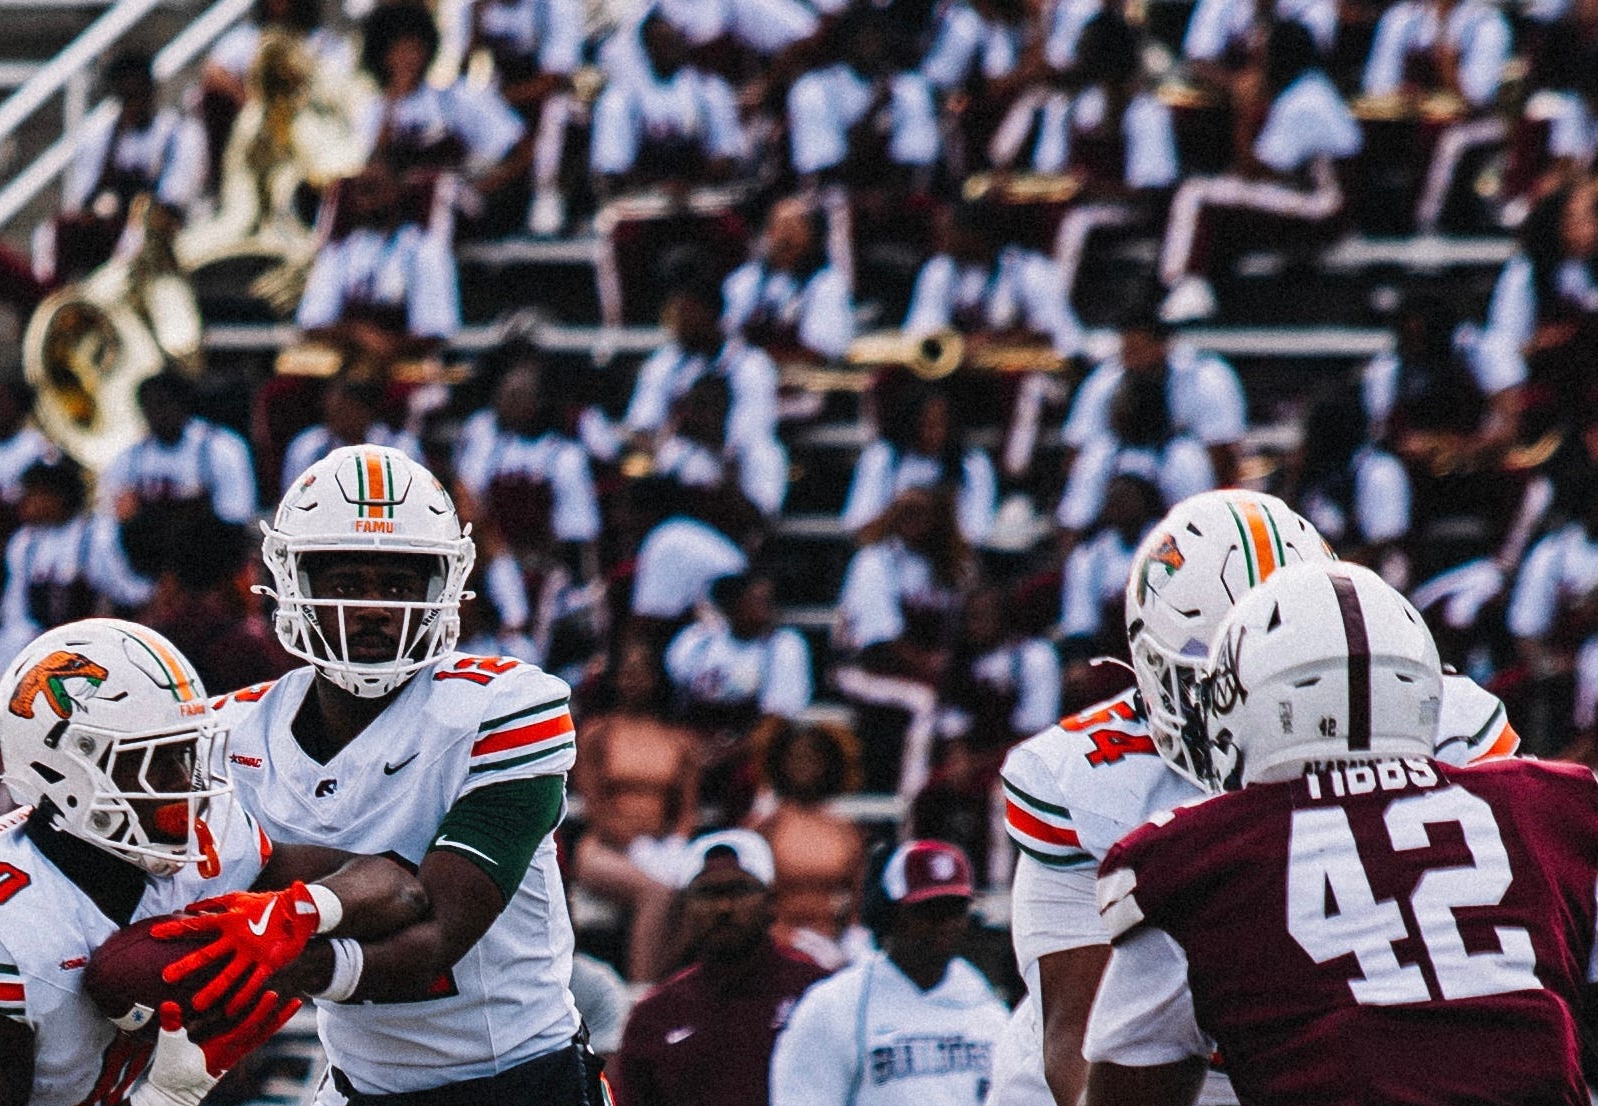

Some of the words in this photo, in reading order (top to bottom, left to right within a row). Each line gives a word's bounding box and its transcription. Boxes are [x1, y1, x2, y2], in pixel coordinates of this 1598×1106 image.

[355, 520, 394, 533] FAMU
[1059, 700, 1162, 769] 54
[1318, 717, 1338, 738] 42
[1286, 785, 1545, 1006] 42
